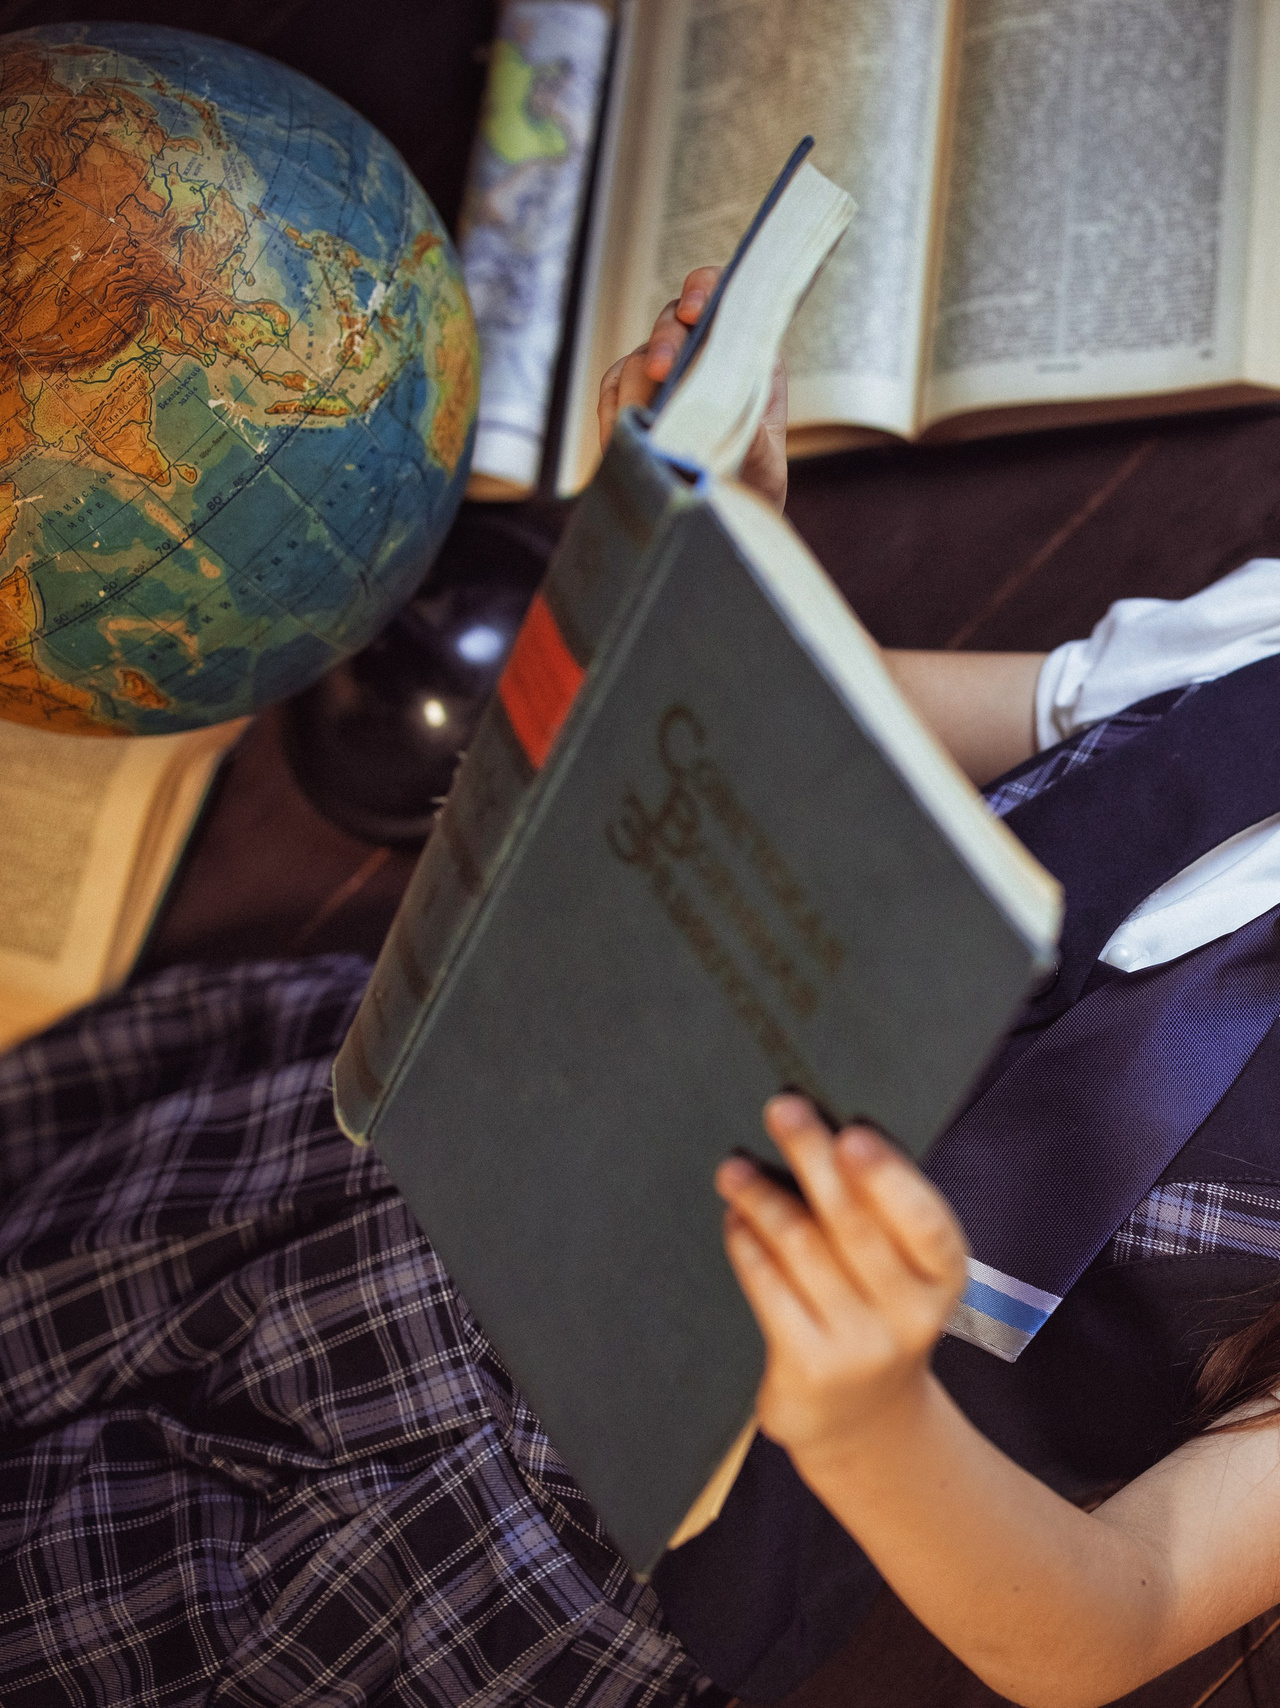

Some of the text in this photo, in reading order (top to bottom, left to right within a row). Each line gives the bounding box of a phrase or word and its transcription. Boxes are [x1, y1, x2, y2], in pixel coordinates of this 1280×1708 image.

[157, 366, 201, 411] Бенгальский
[178, 386, 199, 407] залив
[26, 470, 116, 537] АРАВИЙСКОЕ
[67, 501, 104, 531] МОРЕ
